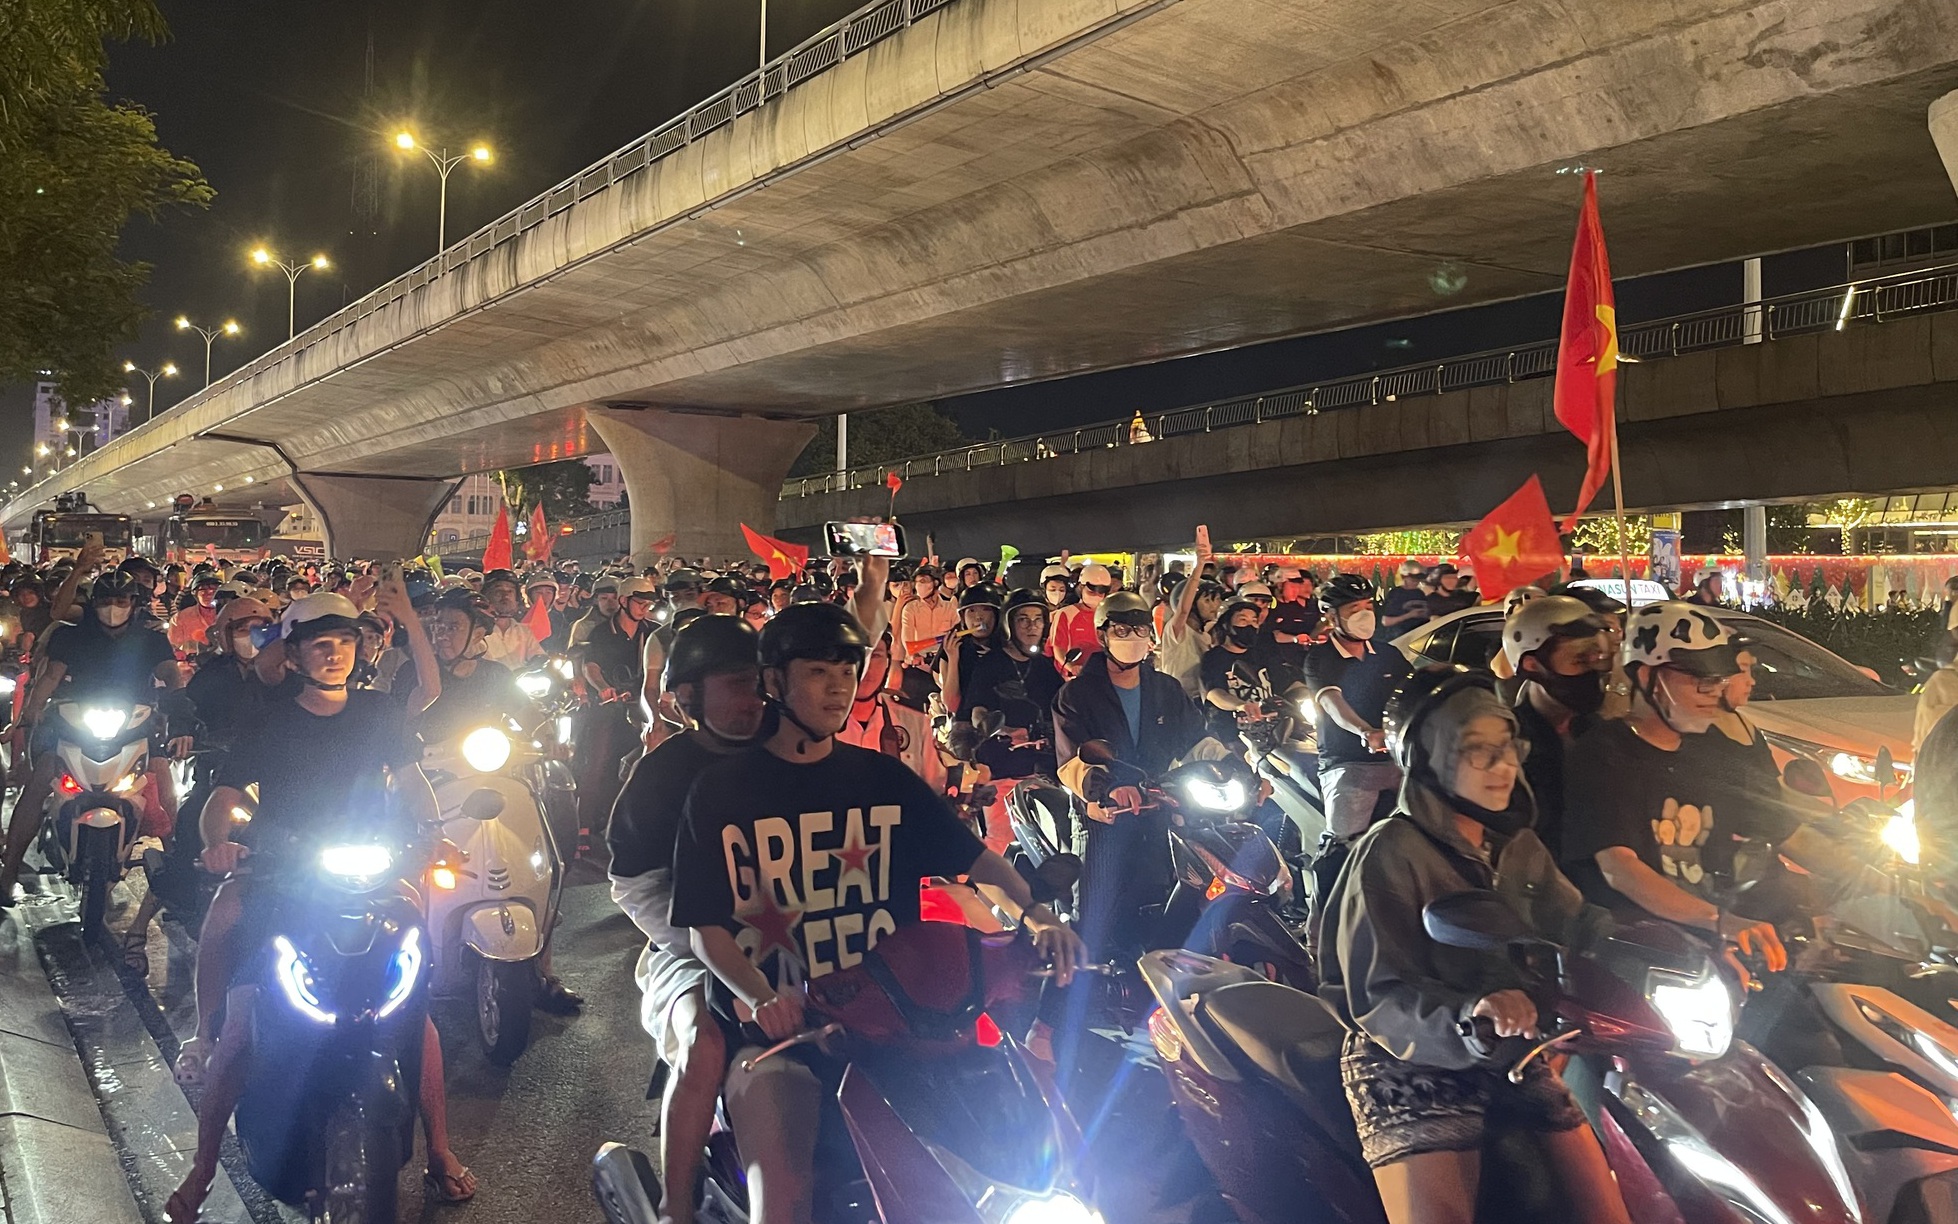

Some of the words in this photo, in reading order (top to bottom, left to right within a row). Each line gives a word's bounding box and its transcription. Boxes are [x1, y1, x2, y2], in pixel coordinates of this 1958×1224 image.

[1594, 584, 1637, 595] NASUN
[1638, 584, 1661, 594] TAXI
[722, 805, 901, 912] GREAT
